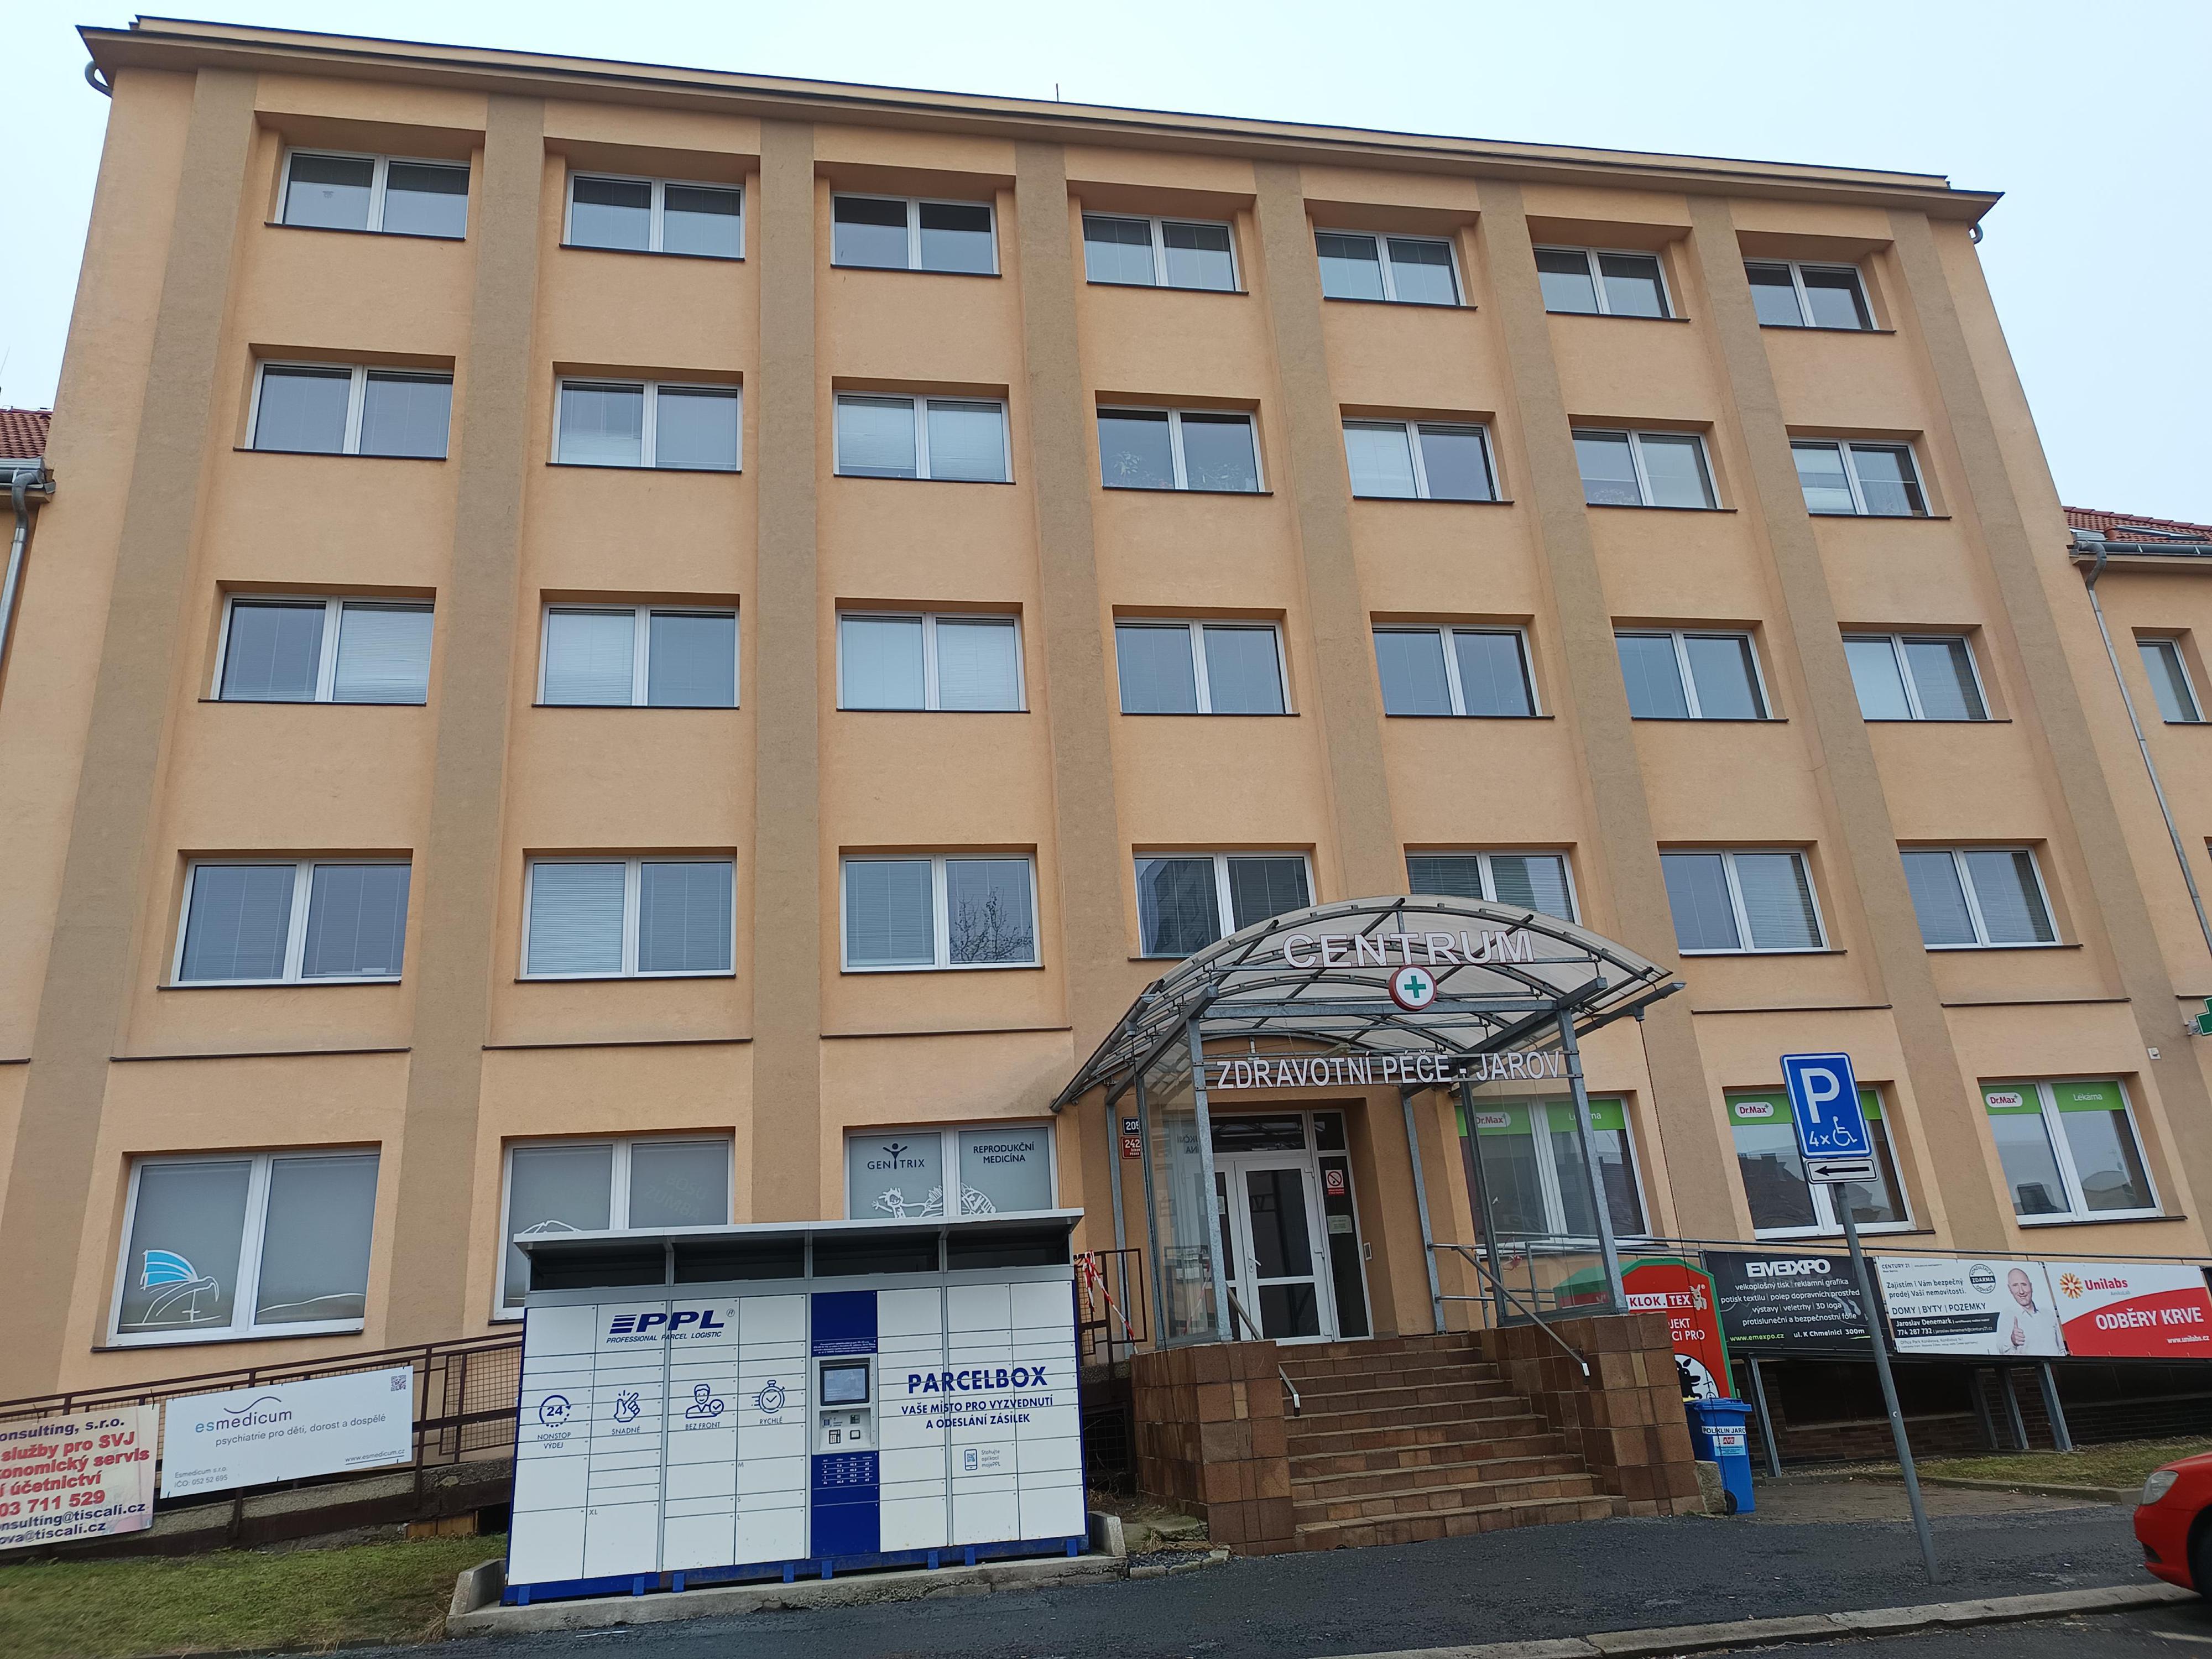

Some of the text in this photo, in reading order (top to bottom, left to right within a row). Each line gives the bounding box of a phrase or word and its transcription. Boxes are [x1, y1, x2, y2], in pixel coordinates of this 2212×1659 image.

[1283, 930, 1535, 968] CENTRUM
[1217, 1051, 1373, 1089] ZDRAVOTNÍ
[1383, 1050, 1453, 1084] PÉČE
[1476, 1051, 1559, 1082] JAROV
[1799, 1068, 1840, 1123] P
[1125, 1121, 1139, 1130] 205
[1125, 1139, 1140, 1148] 242
[1809, 1131, 1831, 1146] 4x
[973, 1141, 1035, 1154] REPRODUKČNÍ
[983, 1154, 1026, 1164] MEDICÍNA
[1735, 1282, 1776, 1291] velkoplošný
[1794, 1279, 1824, 1287] reklamní
[1825, 1278, 1849, 1287] grafika
[1886, 1280, 1913, 1290] Zajistím
[1934, 1277, 1963, 1287] bezpečný
[2085, 1277, 2128, 1291] Unilabs
[1720, 1289, 1860, 1304] potisk textilu polep dopravních prostřed
[1888, 1290, 1910, 1300] prodej
[1926, 1287, 1966, 1296] nemovitosti.
[1752, 1304, 1778, 1314] výstavy
[1783, 1303, 1811, 1313] veletrhy
[1826, 1301, 1842, 1311] loga
[1892, 1303, 1986, 1315] DOMY BYTY POZEMKY
[636, 1310, 725, 1333] PPL
[1742, 1316, 1788, 1327] protisluneční
[1794, 1313, 1841, 1323] bezpečnostní
[1841, 1312, 1857, 1320] fólie
[1922, 1317, 1952, 1326] Denemark
[2095, 1307, 2204, 1331] ODBĚRY KRVE
[606, 1334, 657, 1344] PROFESSIONAL
[1685, 1329, 1705, 1340] PRO
[908, 1366, 1048, 1394] PARCELBOX
[546, 1405, 563, 1416] 24
[901, 1394, 1053, 1415] VAŠE MÍSTO PRO VYZVEDNUTÍ
[195, 1411, 292, 1433] esmedicum
[759, 1416, 782, 1425] RYCHLÉ
[926, 1413, 1030, 1429] A ODESLÁNÍ ZÁSILEK
[0, 1418, 124, 1442] onsulting, s.r.o.
[216, 1433, 266, 1447] psychiatrie
[268, 1430, 284, 1439] pro
[287, 1425, 307, 1436] děti,
[310, 1421, 340, 1432] dorost
[350, 1413, 386, 1426] dospělé
[537, 1432, 571, 1440] NONSTOP
[612, 1426, 640, 1435] SNADNÉ
[1, 1431, 135, 1462] služby pro SVJ
[345, 1449, 405, 1462] www.esmedicum.cz
[0, 1448, 150, 1479] onomický servis
[175, 1468, 211, 1478] Esmedicum
[10, 1470, 102, 1496] účetnictví
[0, 1490, 105, 1517] 03 711 529
[0, 1503, 145, 1531] nsulting@tiscali.cz
[0, 1522, 106, 1545] ova@tiscali.cz
